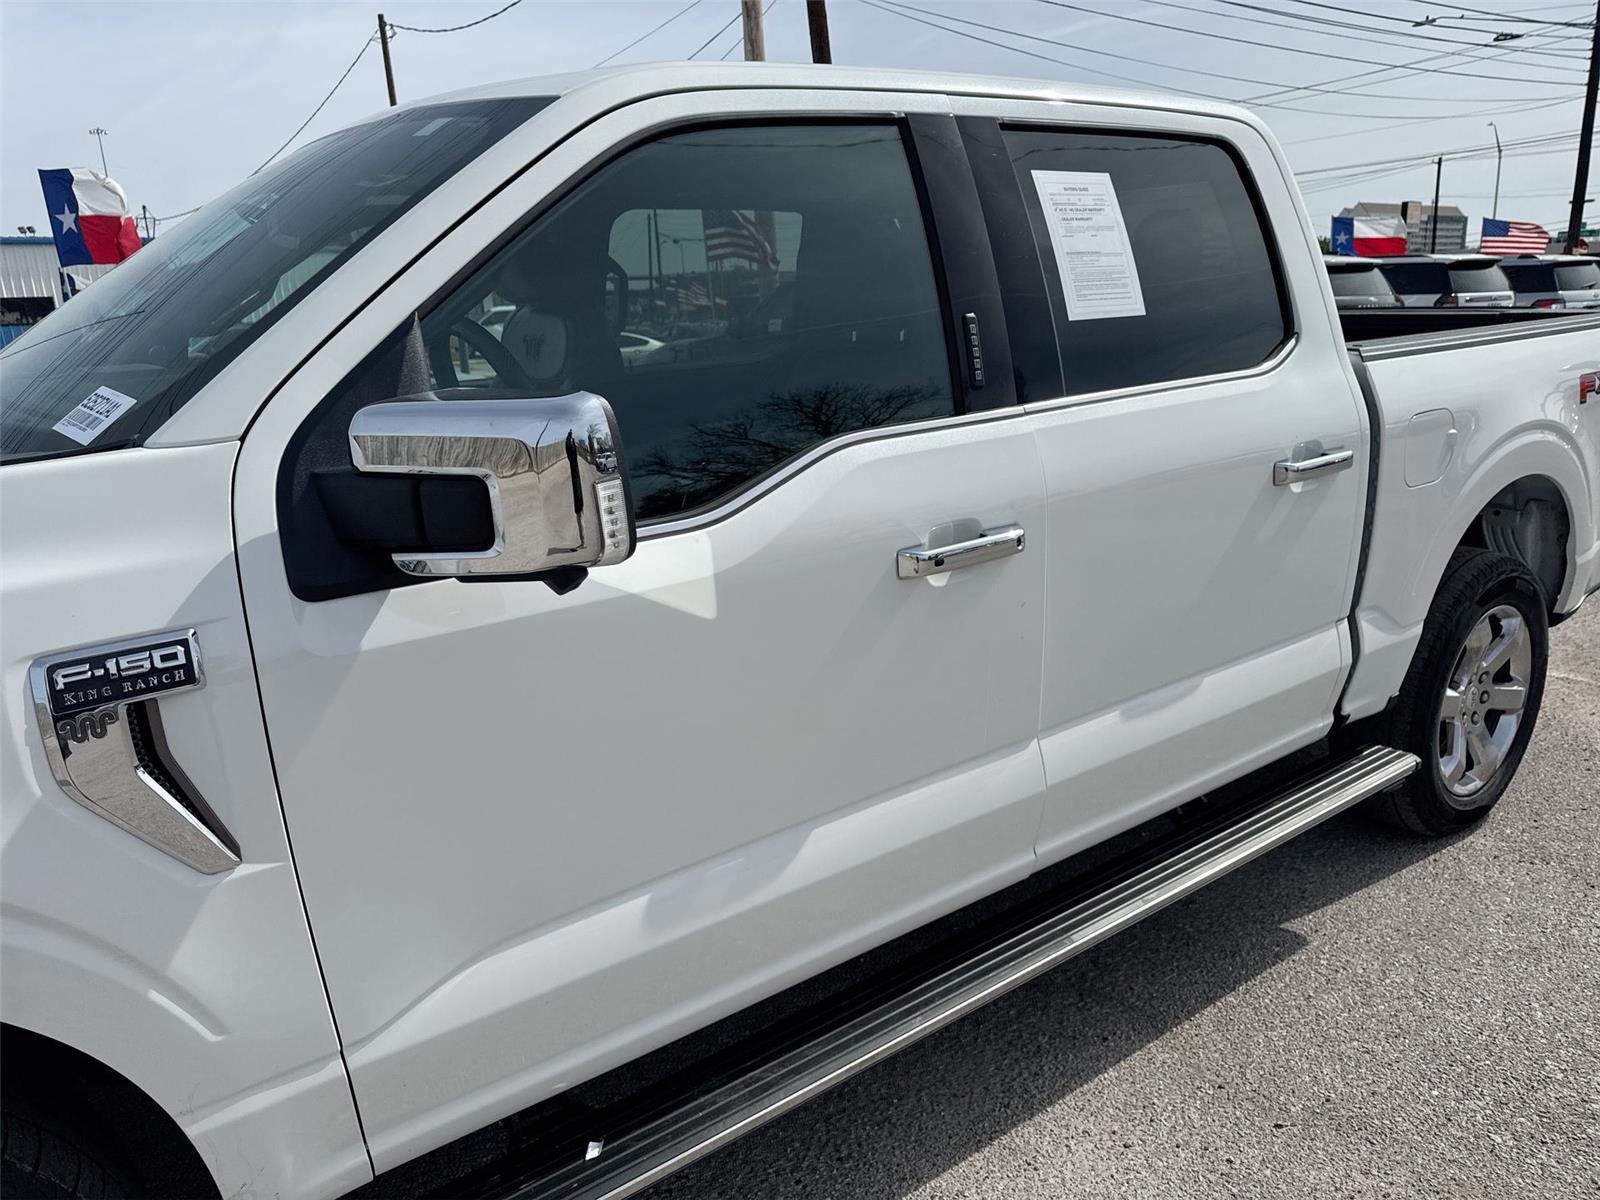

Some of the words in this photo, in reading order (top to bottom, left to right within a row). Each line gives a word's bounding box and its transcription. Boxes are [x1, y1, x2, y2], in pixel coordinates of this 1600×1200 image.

[53, 645, 186, 690] F-150
[63, 686, 112, 705] KING
[122, 669, 185, 692] RANCH
